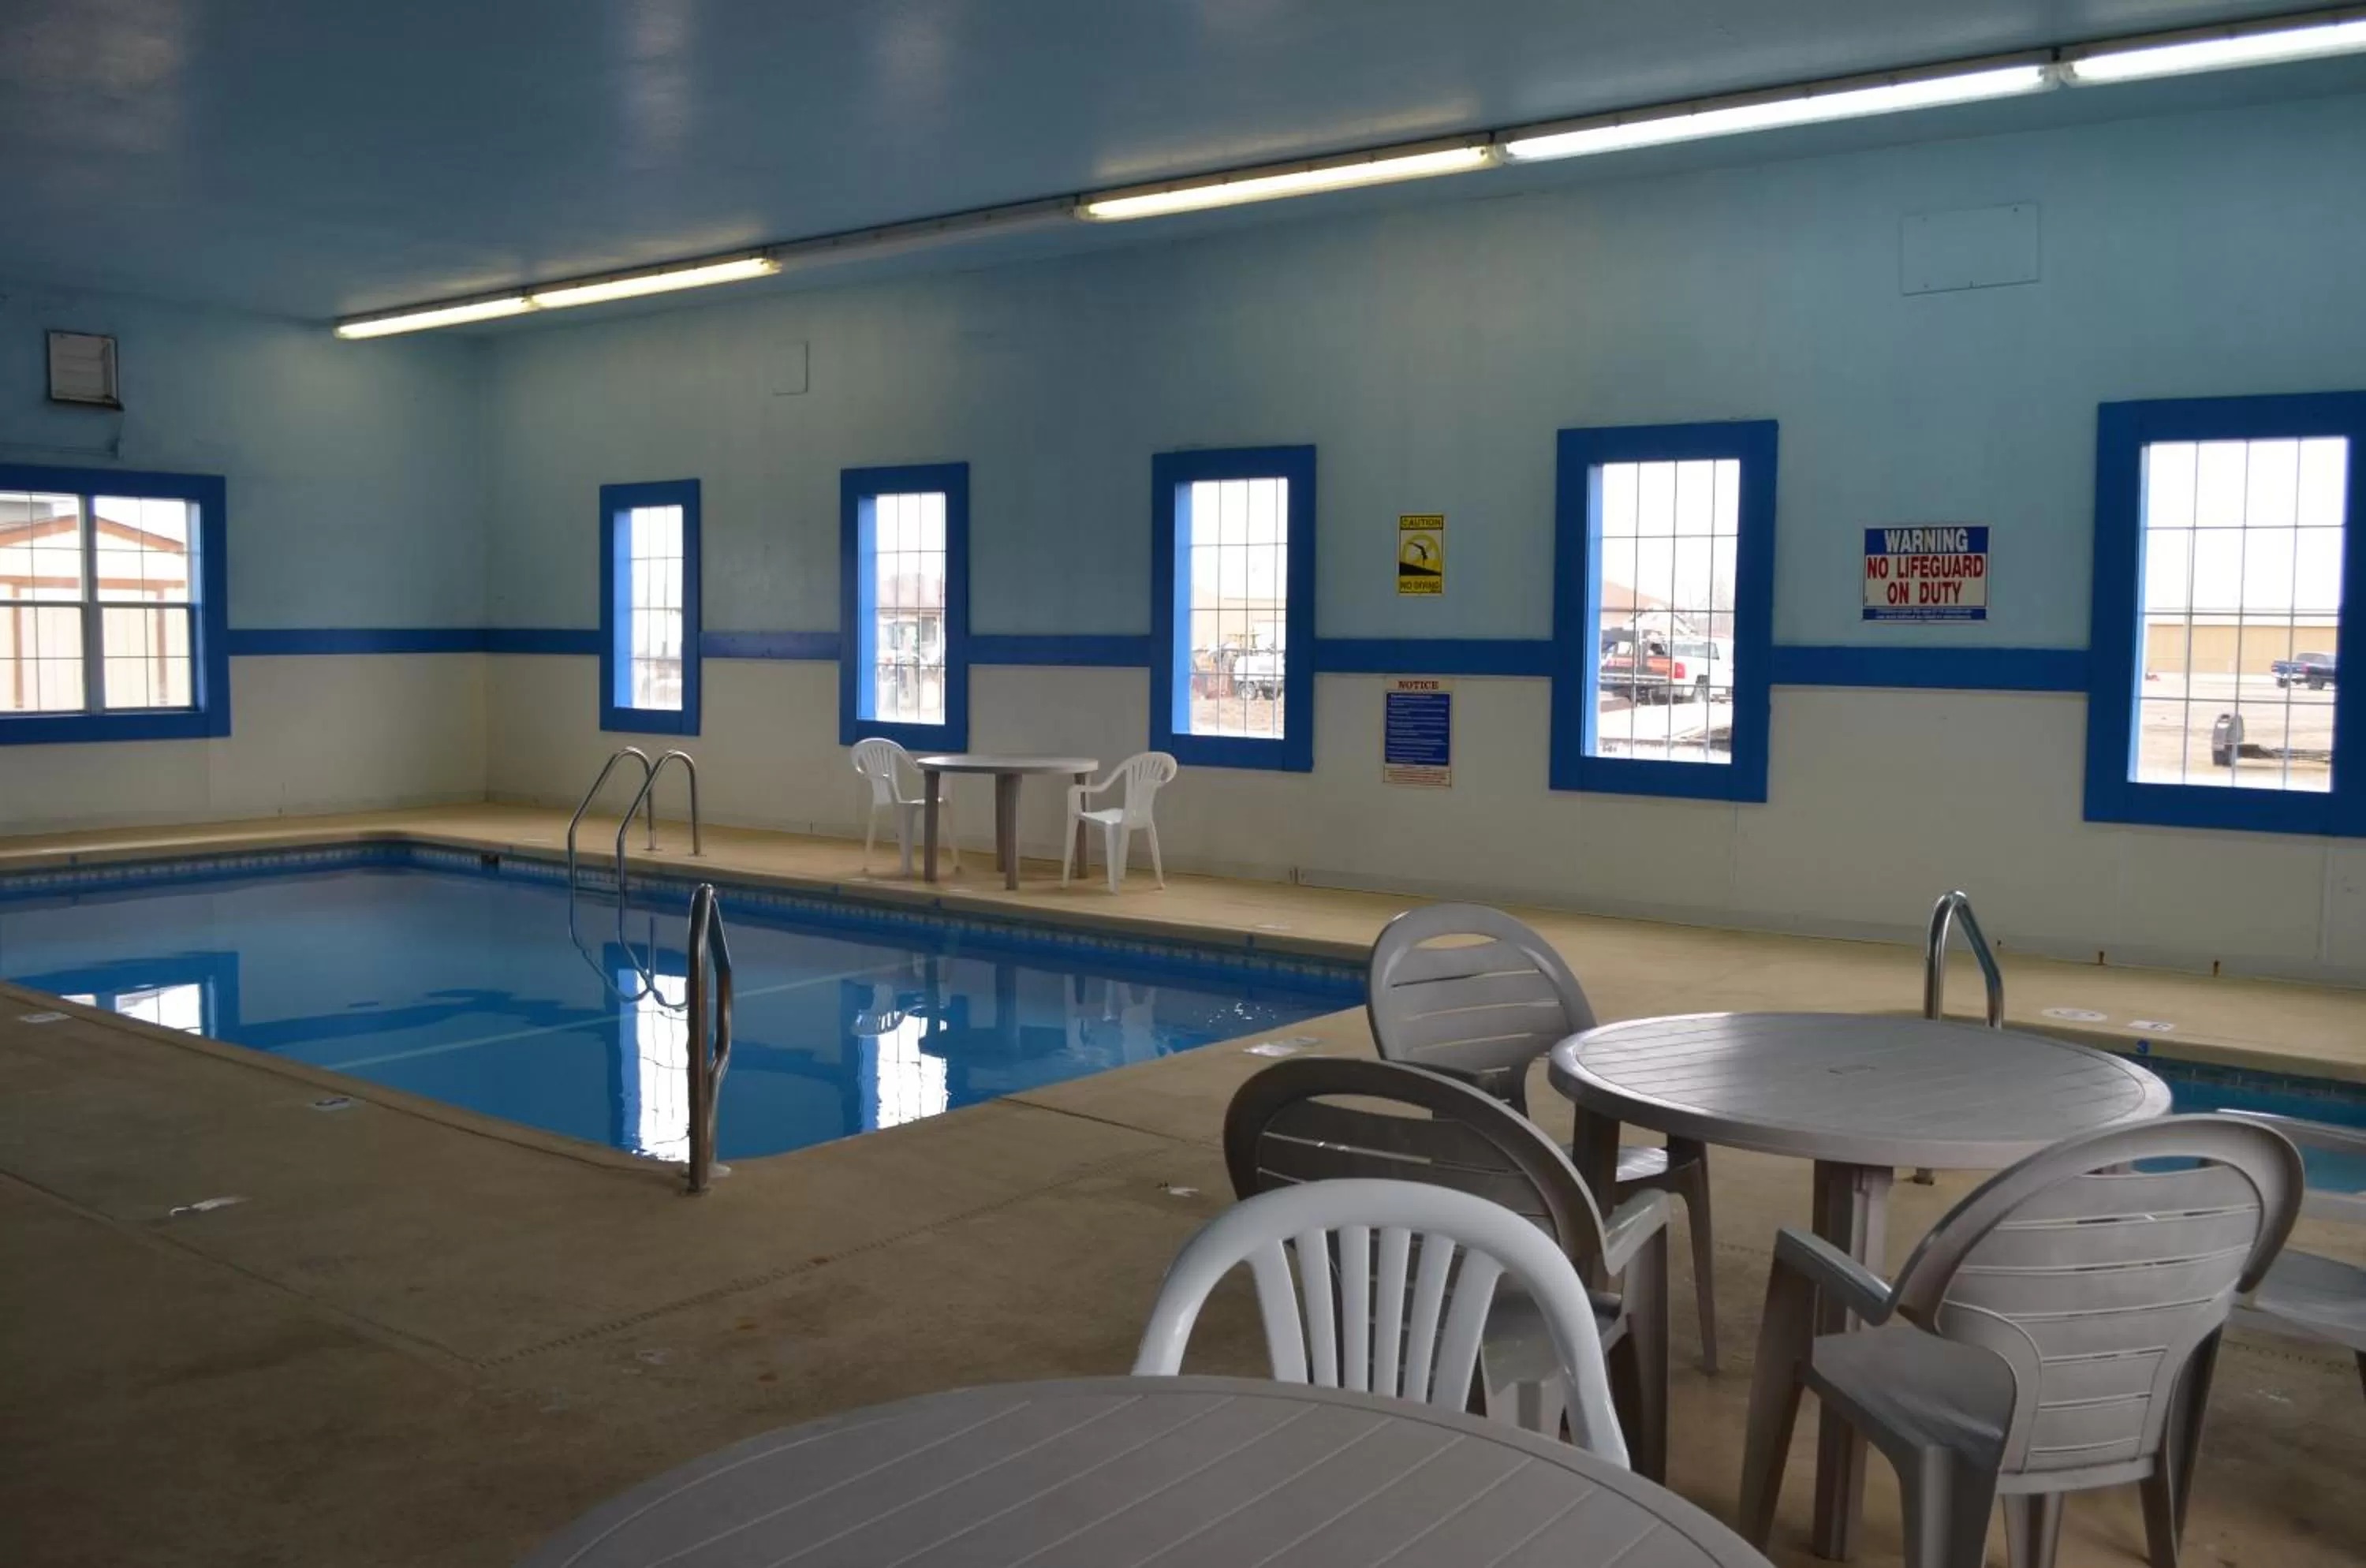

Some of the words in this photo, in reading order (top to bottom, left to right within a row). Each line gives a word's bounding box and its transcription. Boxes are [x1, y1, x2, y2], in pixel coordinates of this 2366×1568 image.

[1884, 528, 1969, 553] WARNING
[1867, 557, 1889, 579] NO
[1897, 555, 1983, 578] LIFEGUARD
[1886, 582, 1909, 605] ON
[1919, 581, 1962, 604] DUTY
[1398, 681, 1439, 689] NOTICE
